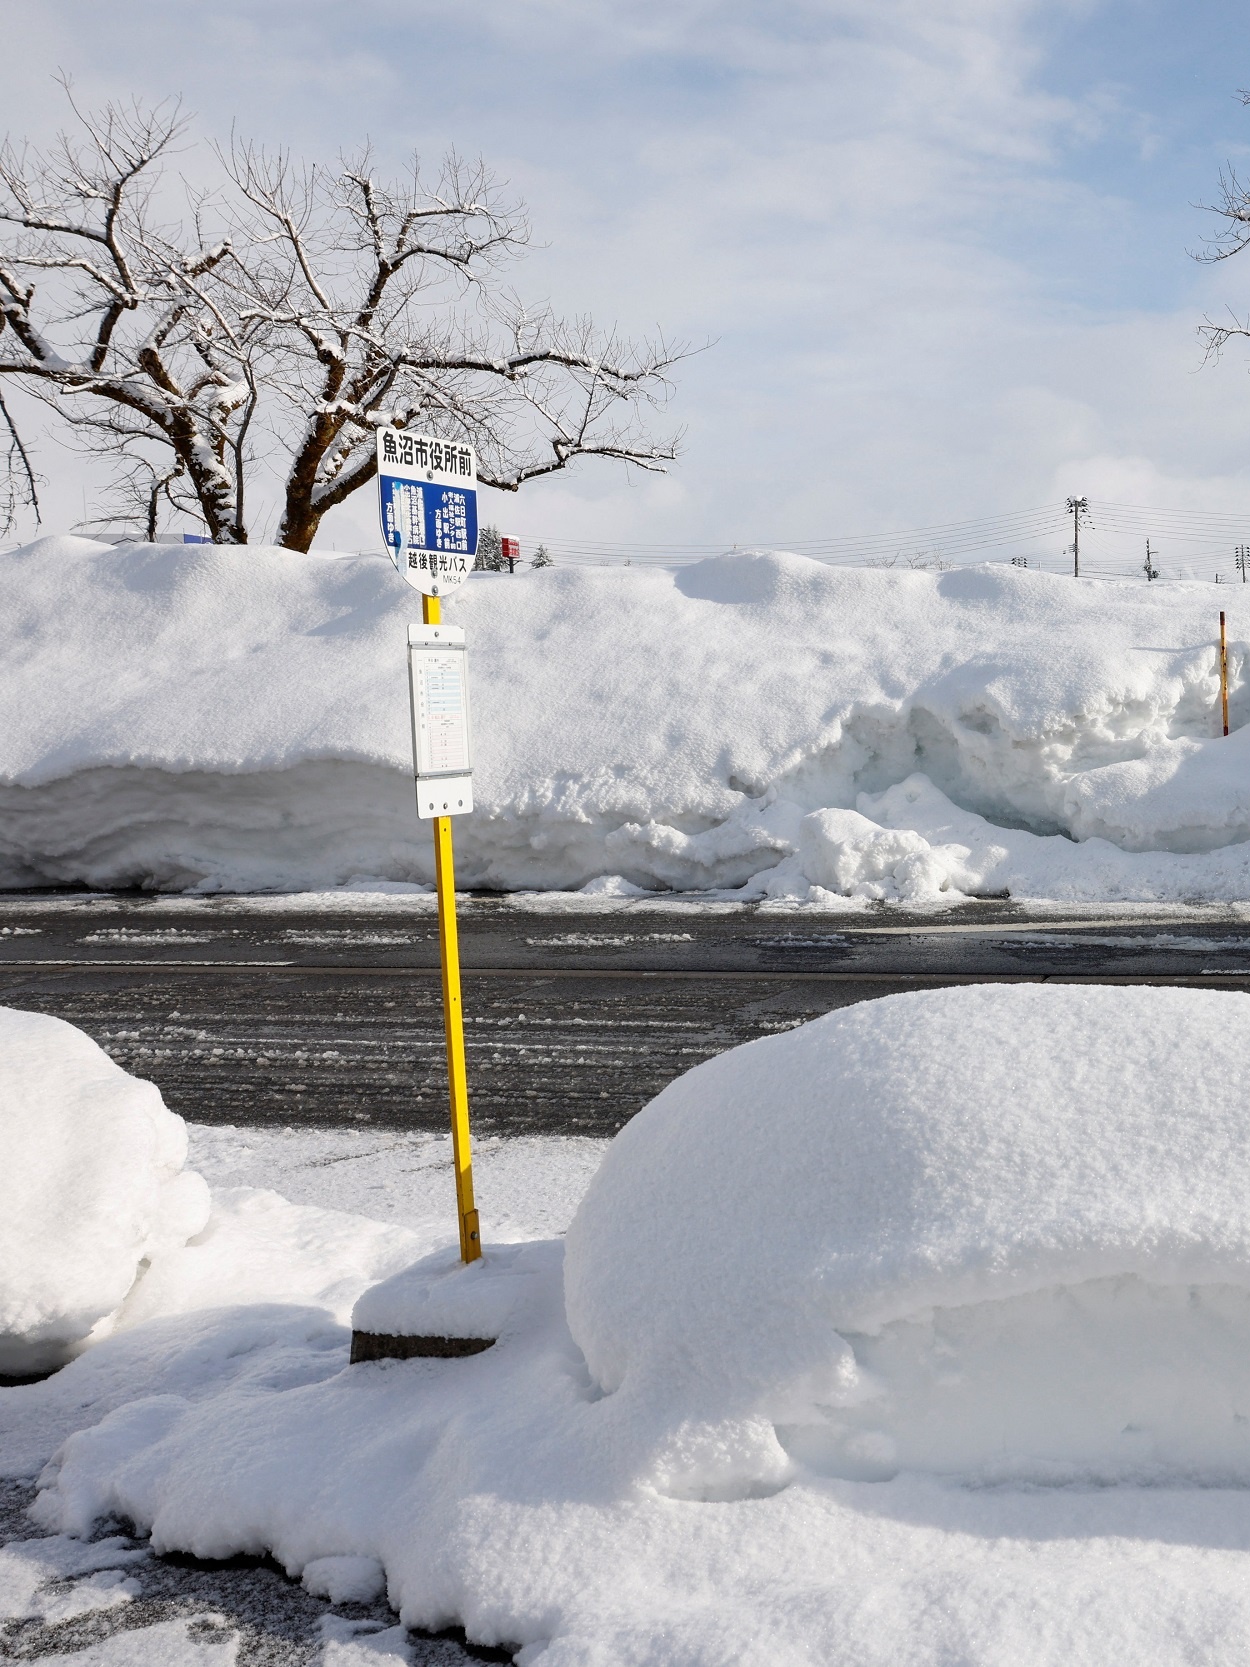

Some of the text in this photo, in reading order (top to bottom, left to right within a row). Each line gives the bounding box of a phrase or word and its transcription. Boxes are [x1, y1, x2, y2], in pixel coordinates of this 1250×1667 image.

[383, 431, 472, 476] 魚沼市役所前
